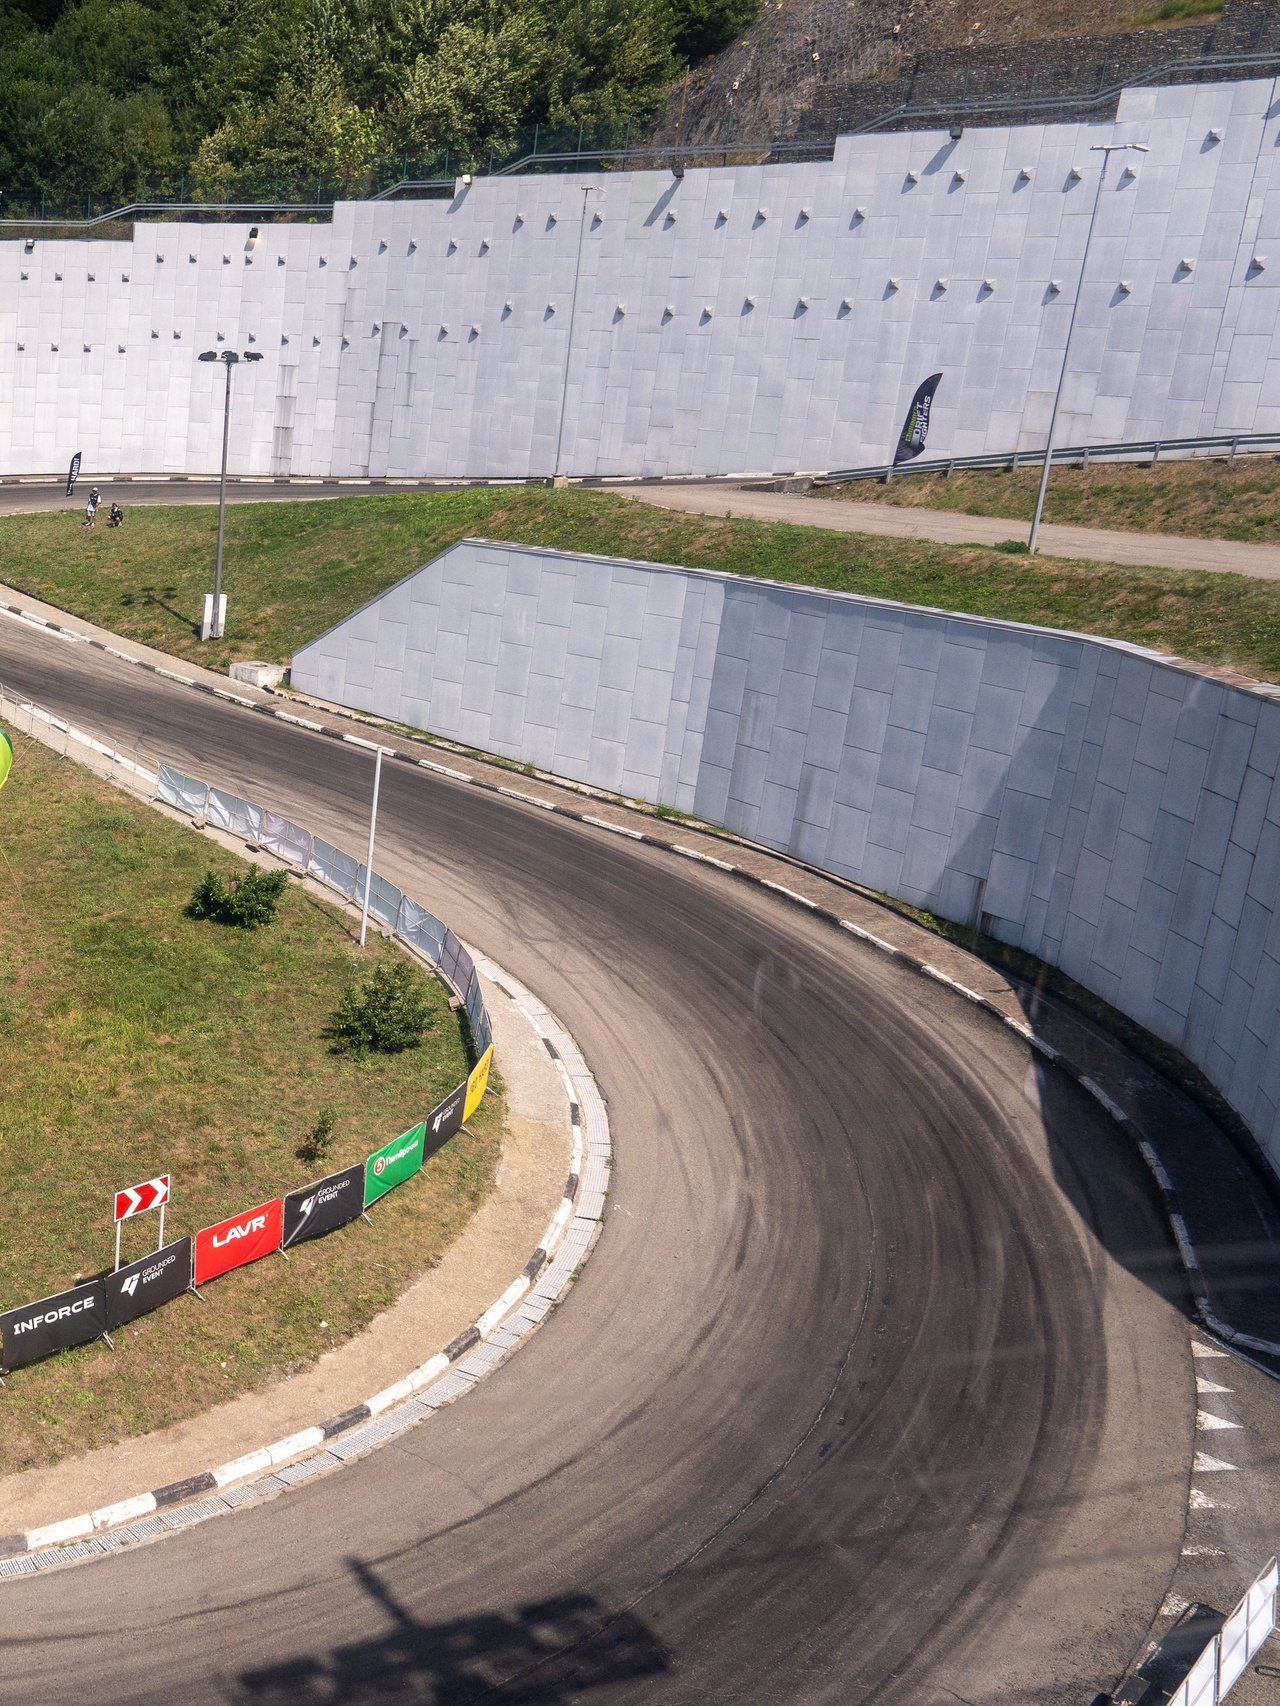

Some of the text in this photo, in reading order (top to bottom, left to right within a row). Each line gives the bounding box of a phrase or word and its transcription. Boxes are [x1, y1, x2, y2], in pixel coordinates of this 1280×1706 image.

[915, 401, 924, 436] DRIFT
[318, 1179, 351, 1197] GROUNDED
[318, 1191, 339, 1204] EVENT
[212, 1214, 268, 1249] LAVR
[142, 1254, 176, 1277] GROUNDED
[142, 1267, 164, 1285] EVENT
[13, 1296, 95, 1336] INFORCE
